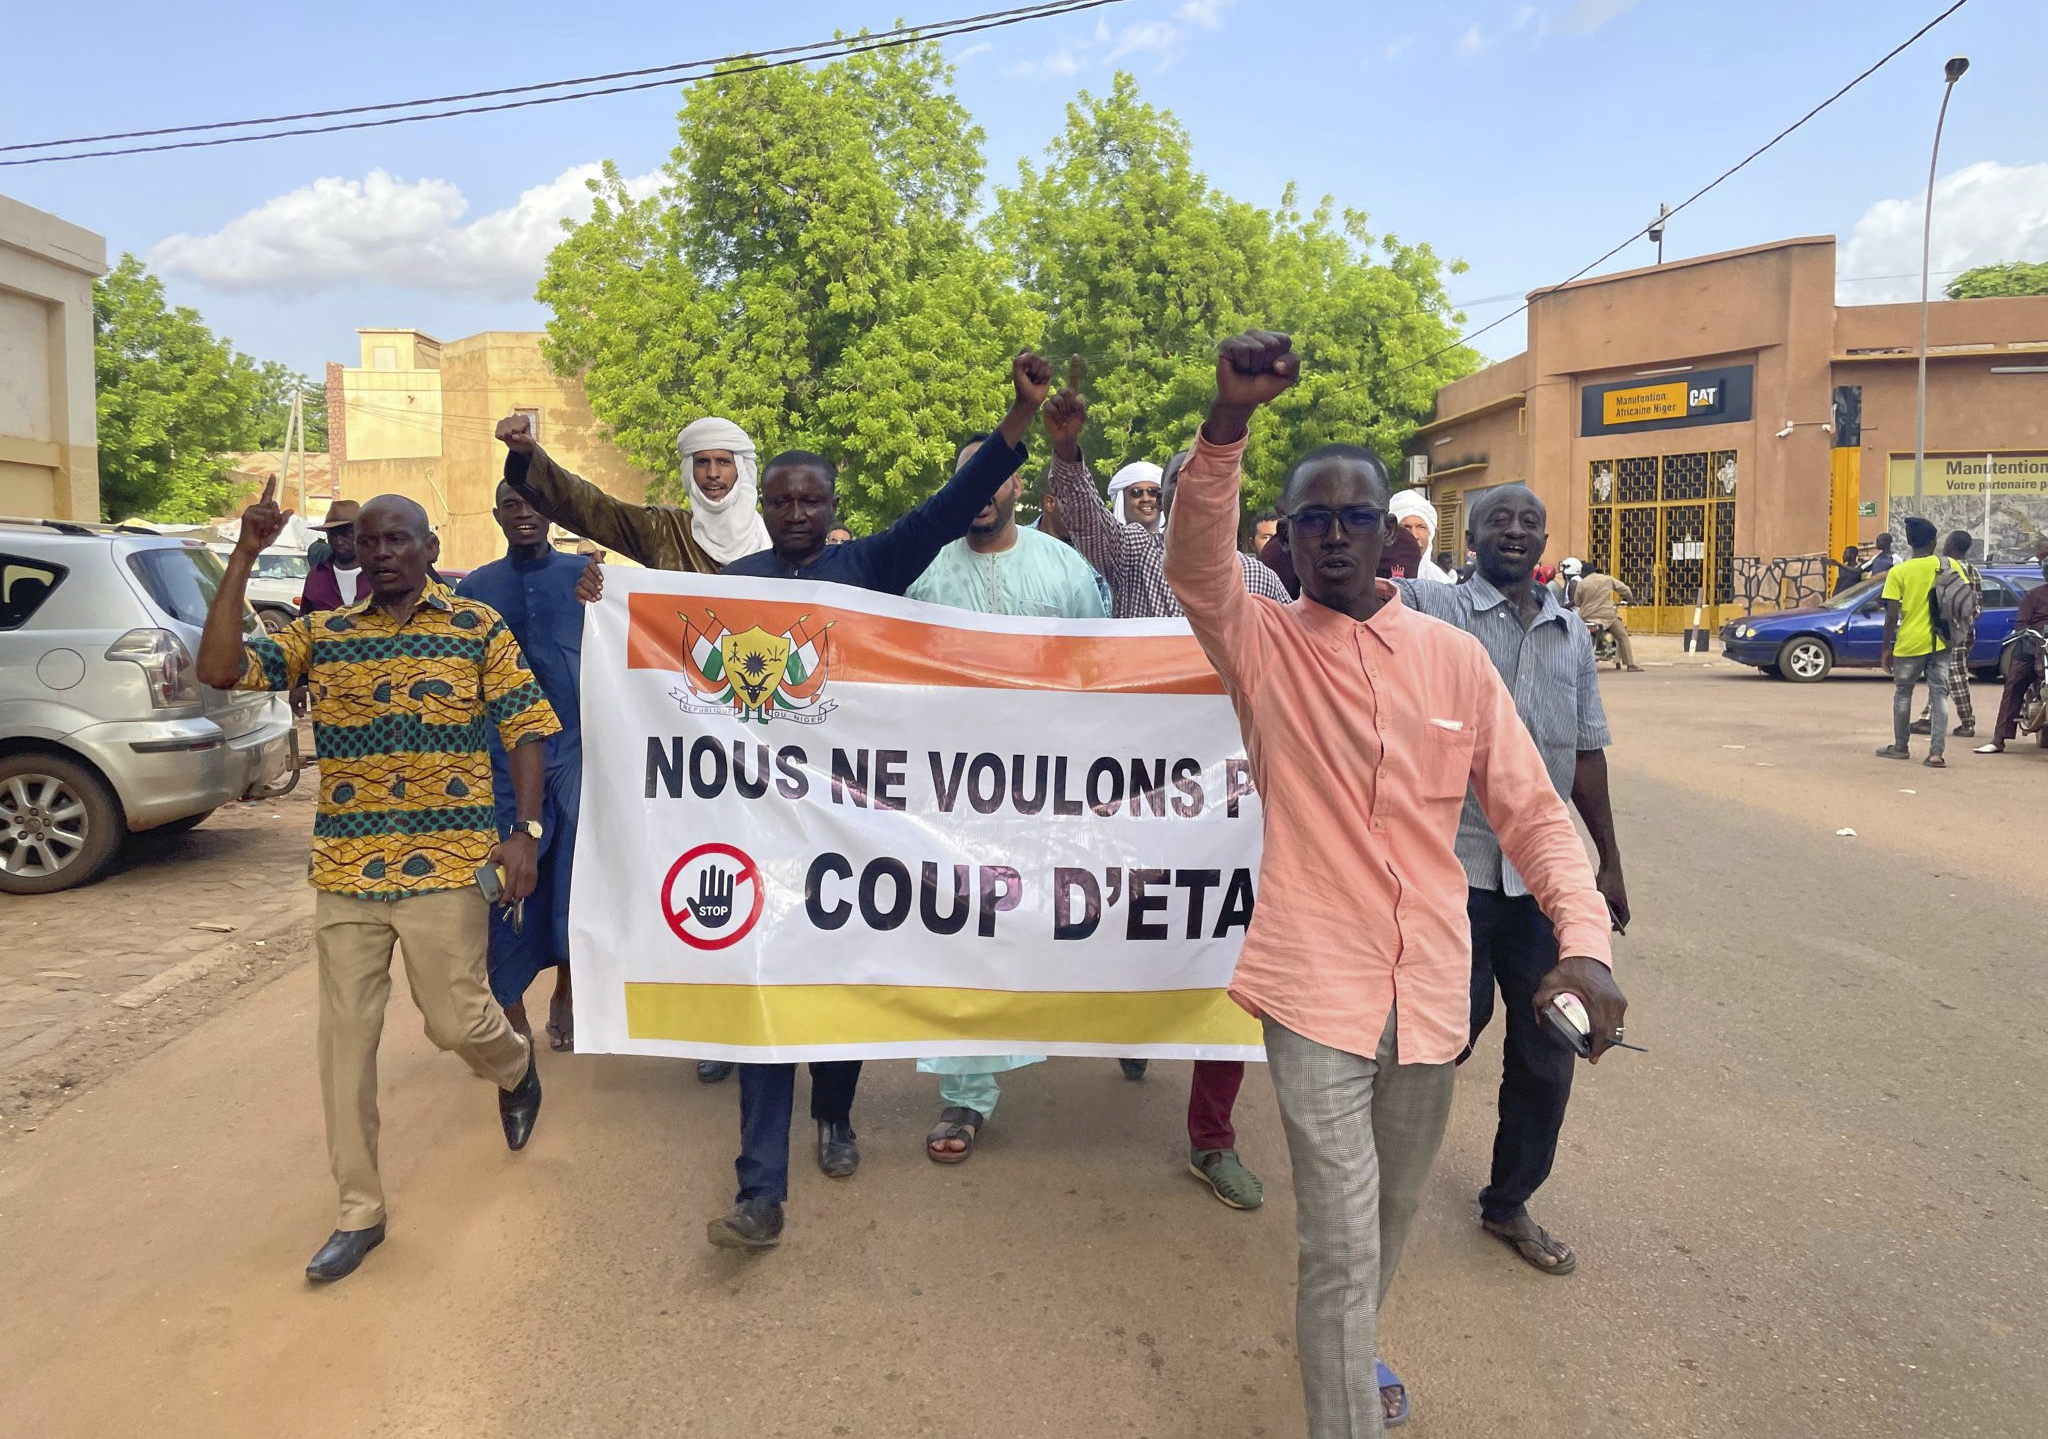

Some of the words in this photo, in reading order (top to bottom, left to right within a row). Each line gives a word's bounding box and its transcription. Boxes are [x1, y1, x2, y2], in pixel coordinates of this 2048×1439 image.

[1616, 392, 1666, 405] Manutention
[1689, 387, 1717, 407] CAT
[1616, 405, 1651, 417] Africaine
[1653, 403, 1676, 414] Niger
[1946, 480, 1976, 490] Votre
[2040, 481, 2048, 491] p
[793, 714, 823, 723] NIGER
[644, 735, 809, 800] NOUS
[831, 748, 908, 812] NE
[928, 751, 1205, 818] VOULONS
[1225, 758, 1264, 818] P
[804, 852, 1023, 938] COUP
[1053, 867, 1255, 940] D'ETA
[698, 905, 729, 917] STOP
